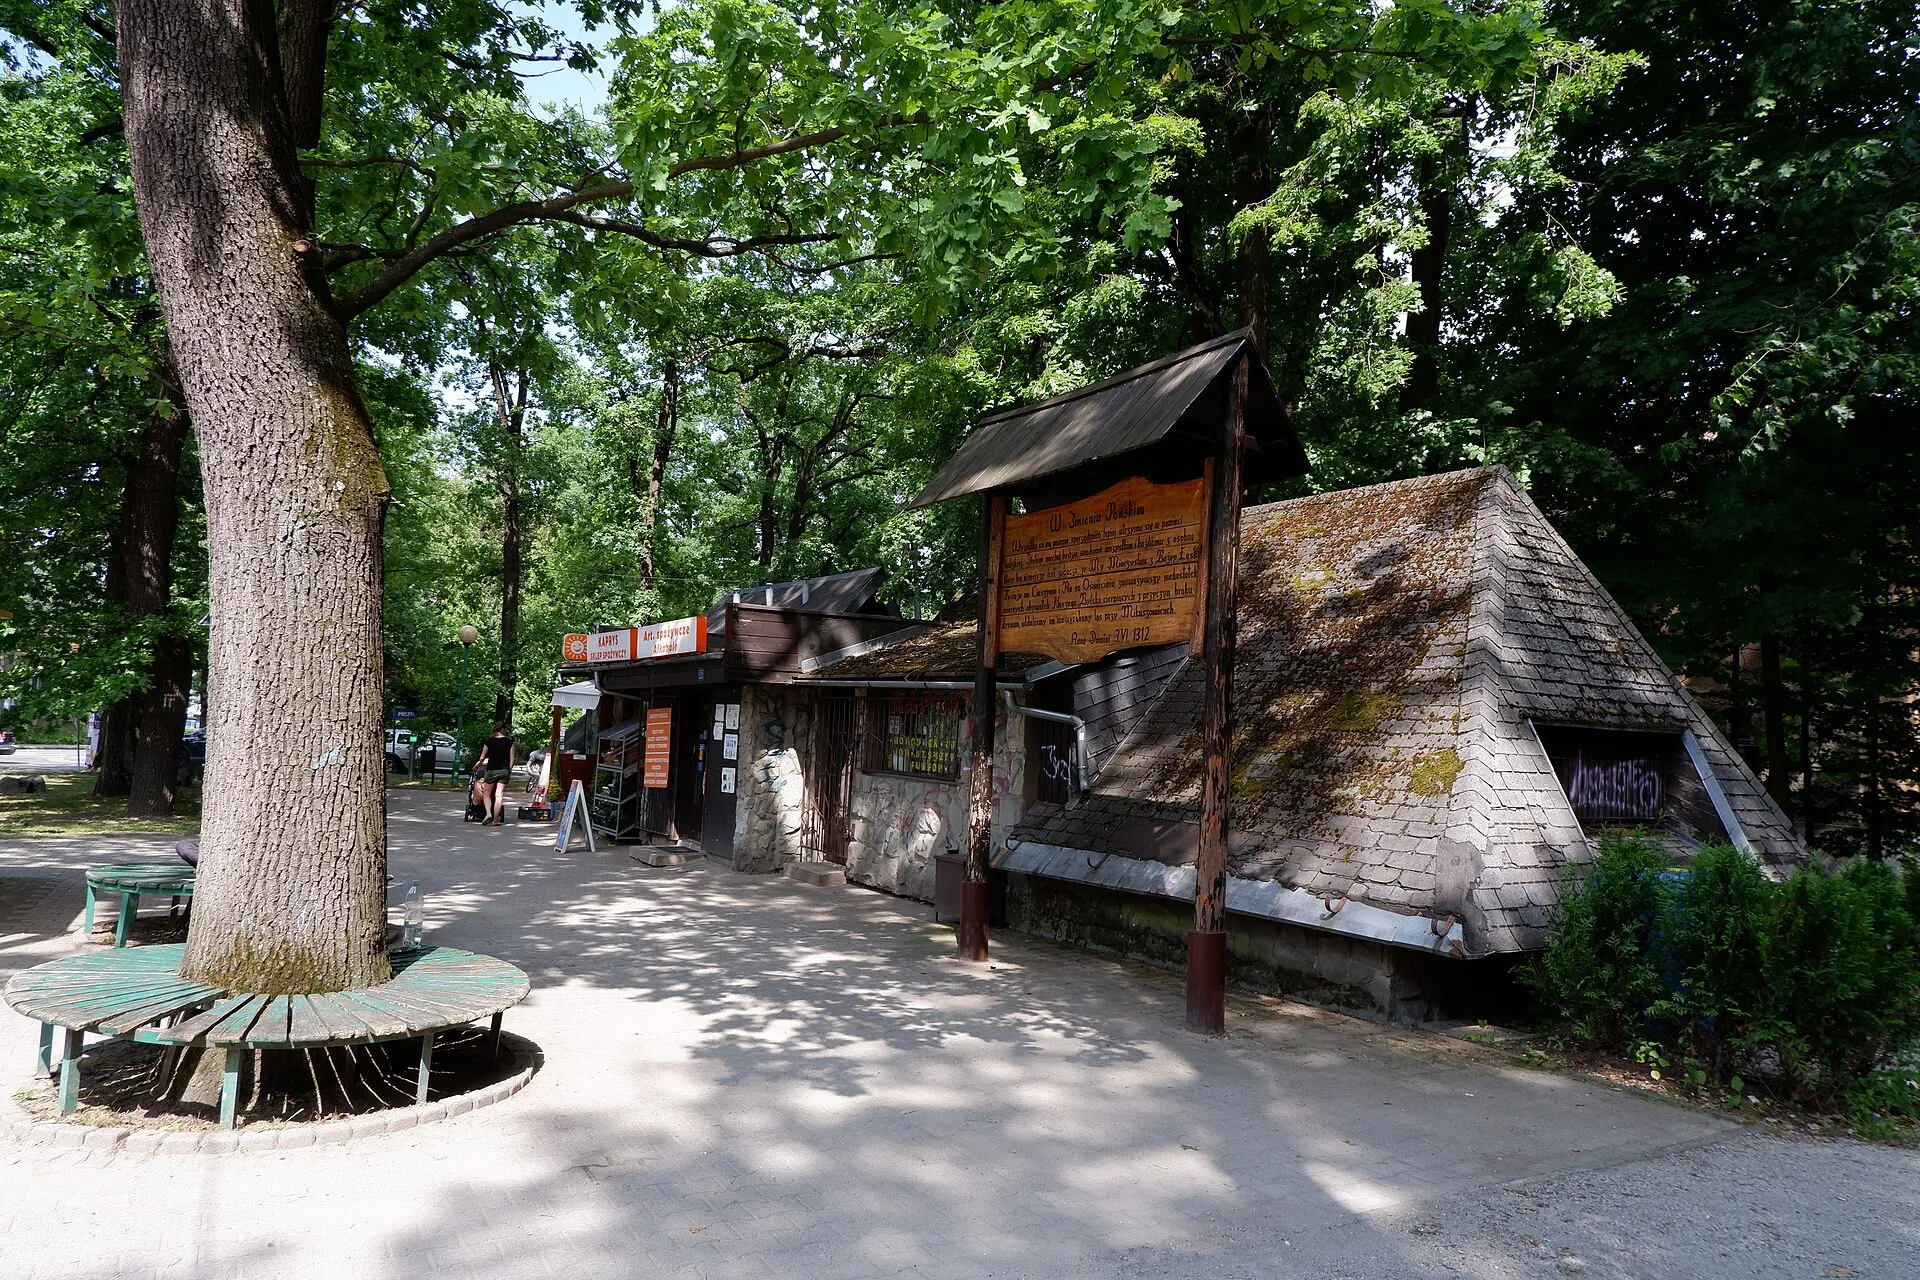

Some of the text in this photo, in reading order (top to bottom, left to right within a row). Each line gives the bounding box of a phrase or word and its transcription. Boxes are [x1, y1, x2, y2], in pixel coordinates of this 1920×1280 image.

[1050, 499, 1144, 532] W Imieniu Pańskim
[1162, 515, 1183, 529] pamięci
[1173, 528, 1194, 543] osobna
[1090, 558, 1104, 572] My
[1062, 580, 1072, 594] Pan
[1174, 582, 1192, 596] braku
[1104, 613, 1118, 622] przy
[598, 635, 618, 647] KAPRYS
[644, 626, 690, 642] Art. spożywcze
[1089, 630, 1110, 644] Domini
[1133, 626, 1150, 641] 1312
[591, 649, 626, 660] SKLEP SPOŻYWCZY
[653, 642, 678, 654] Alkohole
